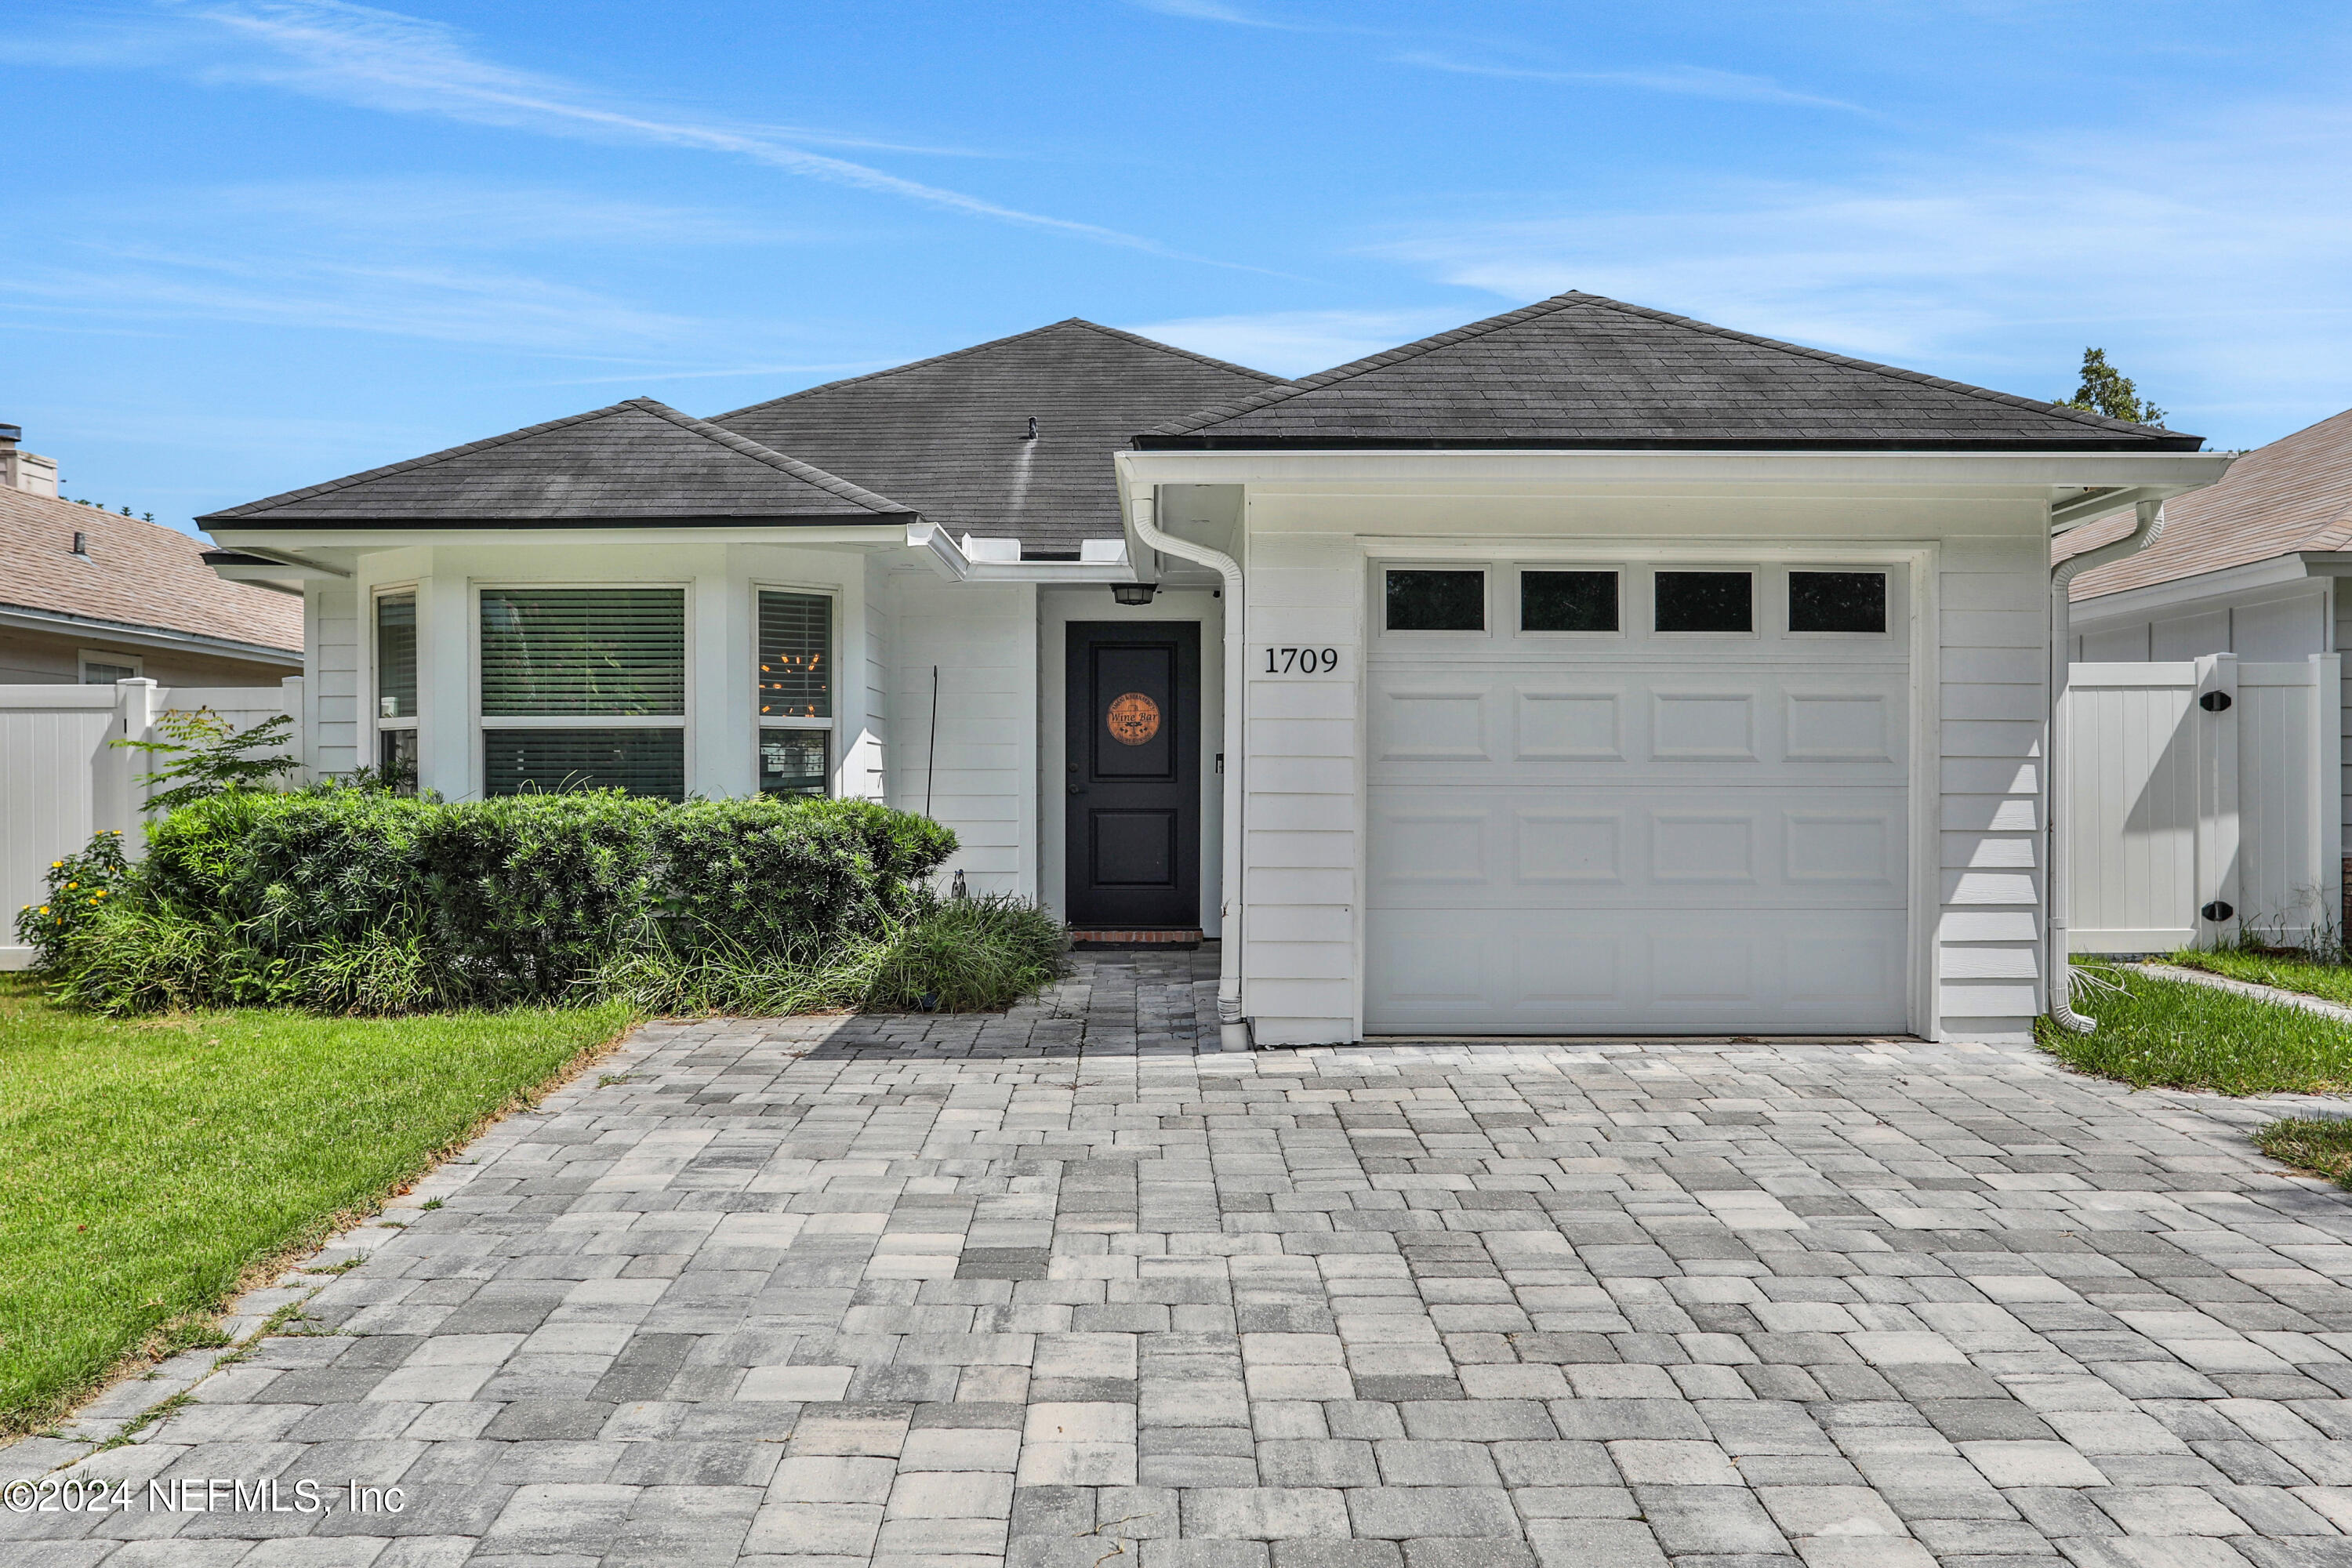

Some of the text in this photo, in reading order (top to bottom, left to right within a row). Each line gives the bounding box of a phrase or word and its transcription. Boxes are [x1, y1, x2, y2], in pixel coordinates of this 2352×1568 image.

[1265, 648, 1338, 673] 1709
[1110, 712, 1159, 722] Wine Bar
